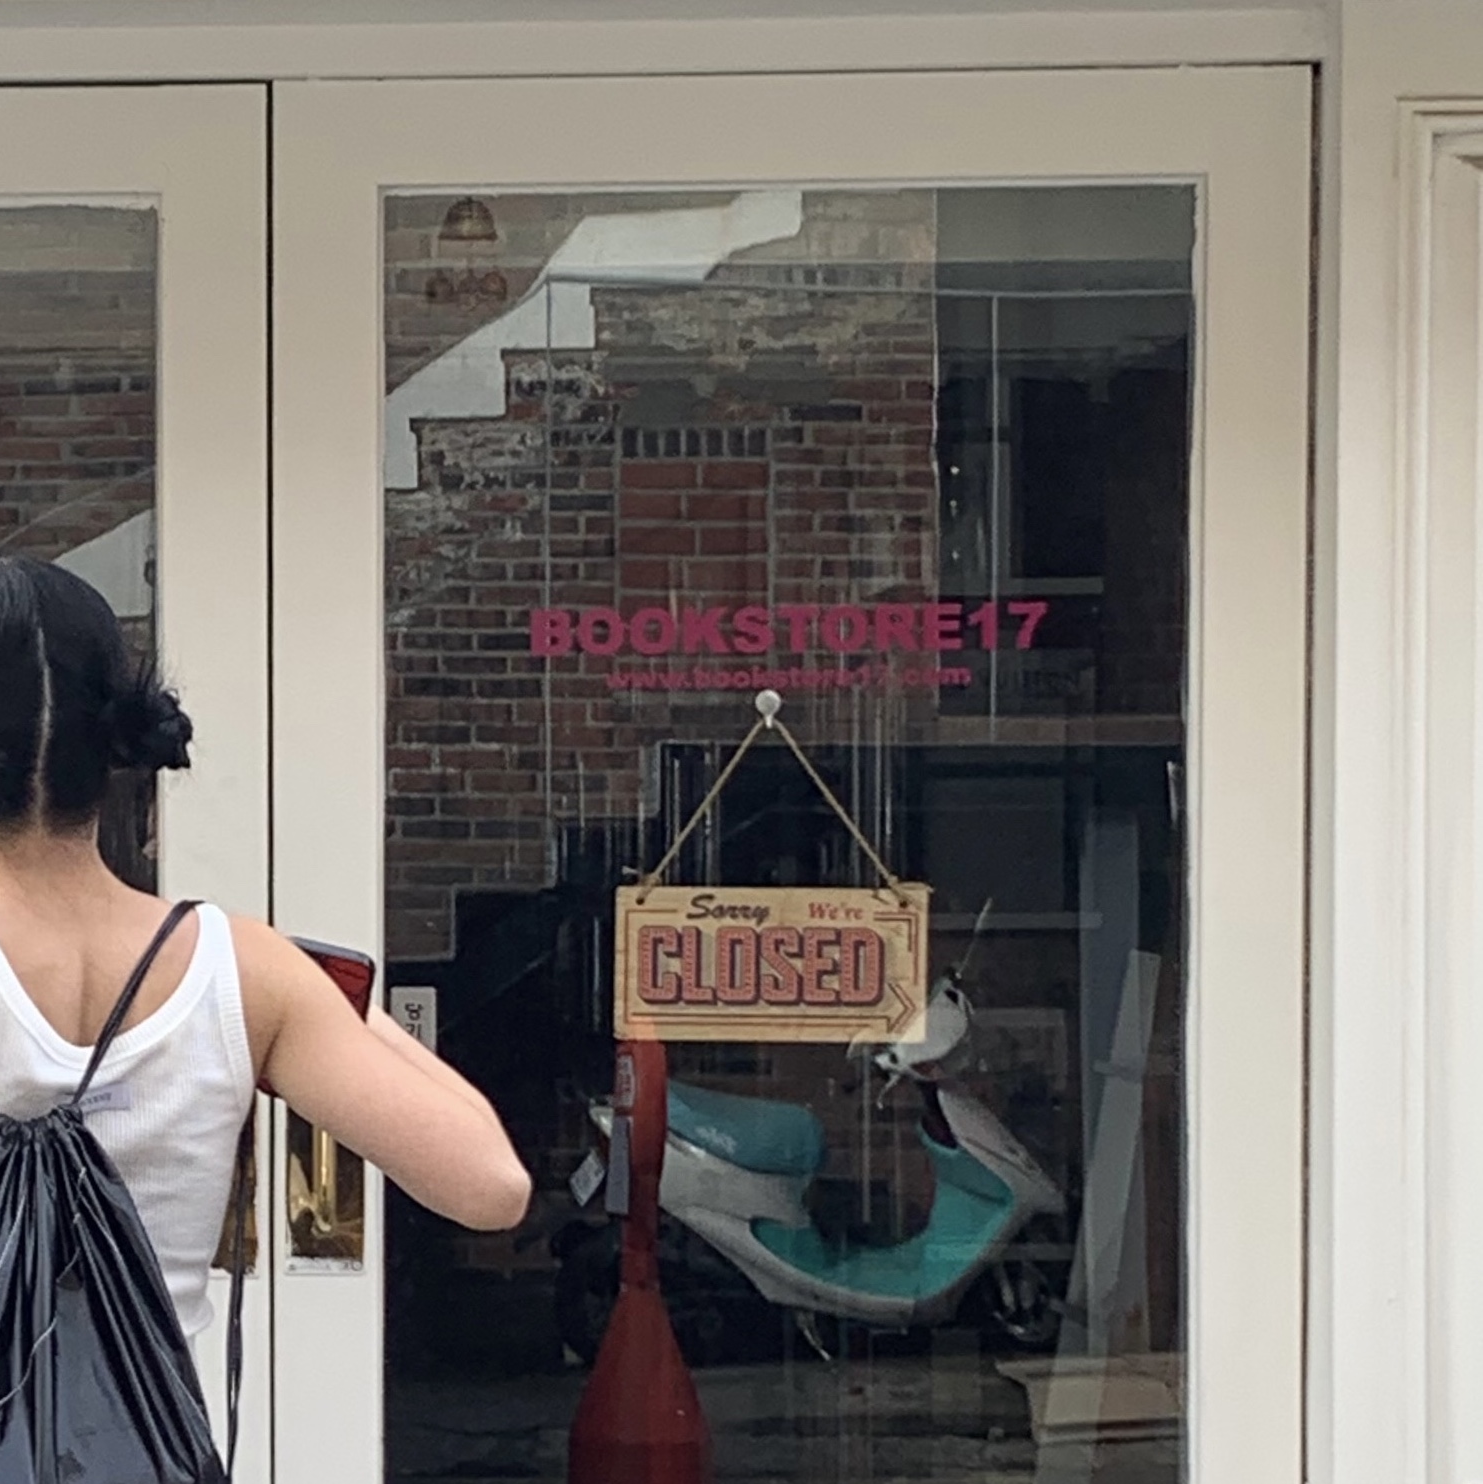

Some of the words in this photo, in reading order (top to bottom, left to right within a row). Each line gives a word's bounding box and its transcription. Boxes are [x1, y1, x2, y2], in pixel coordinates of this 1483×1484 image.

[529, 602, 1049, 656] BOOKSTORE17
[685, 894, 771, 926] Sorry
[807, 902, 864, 920] We're
[637, 924, 886, 1006] CLOSED
